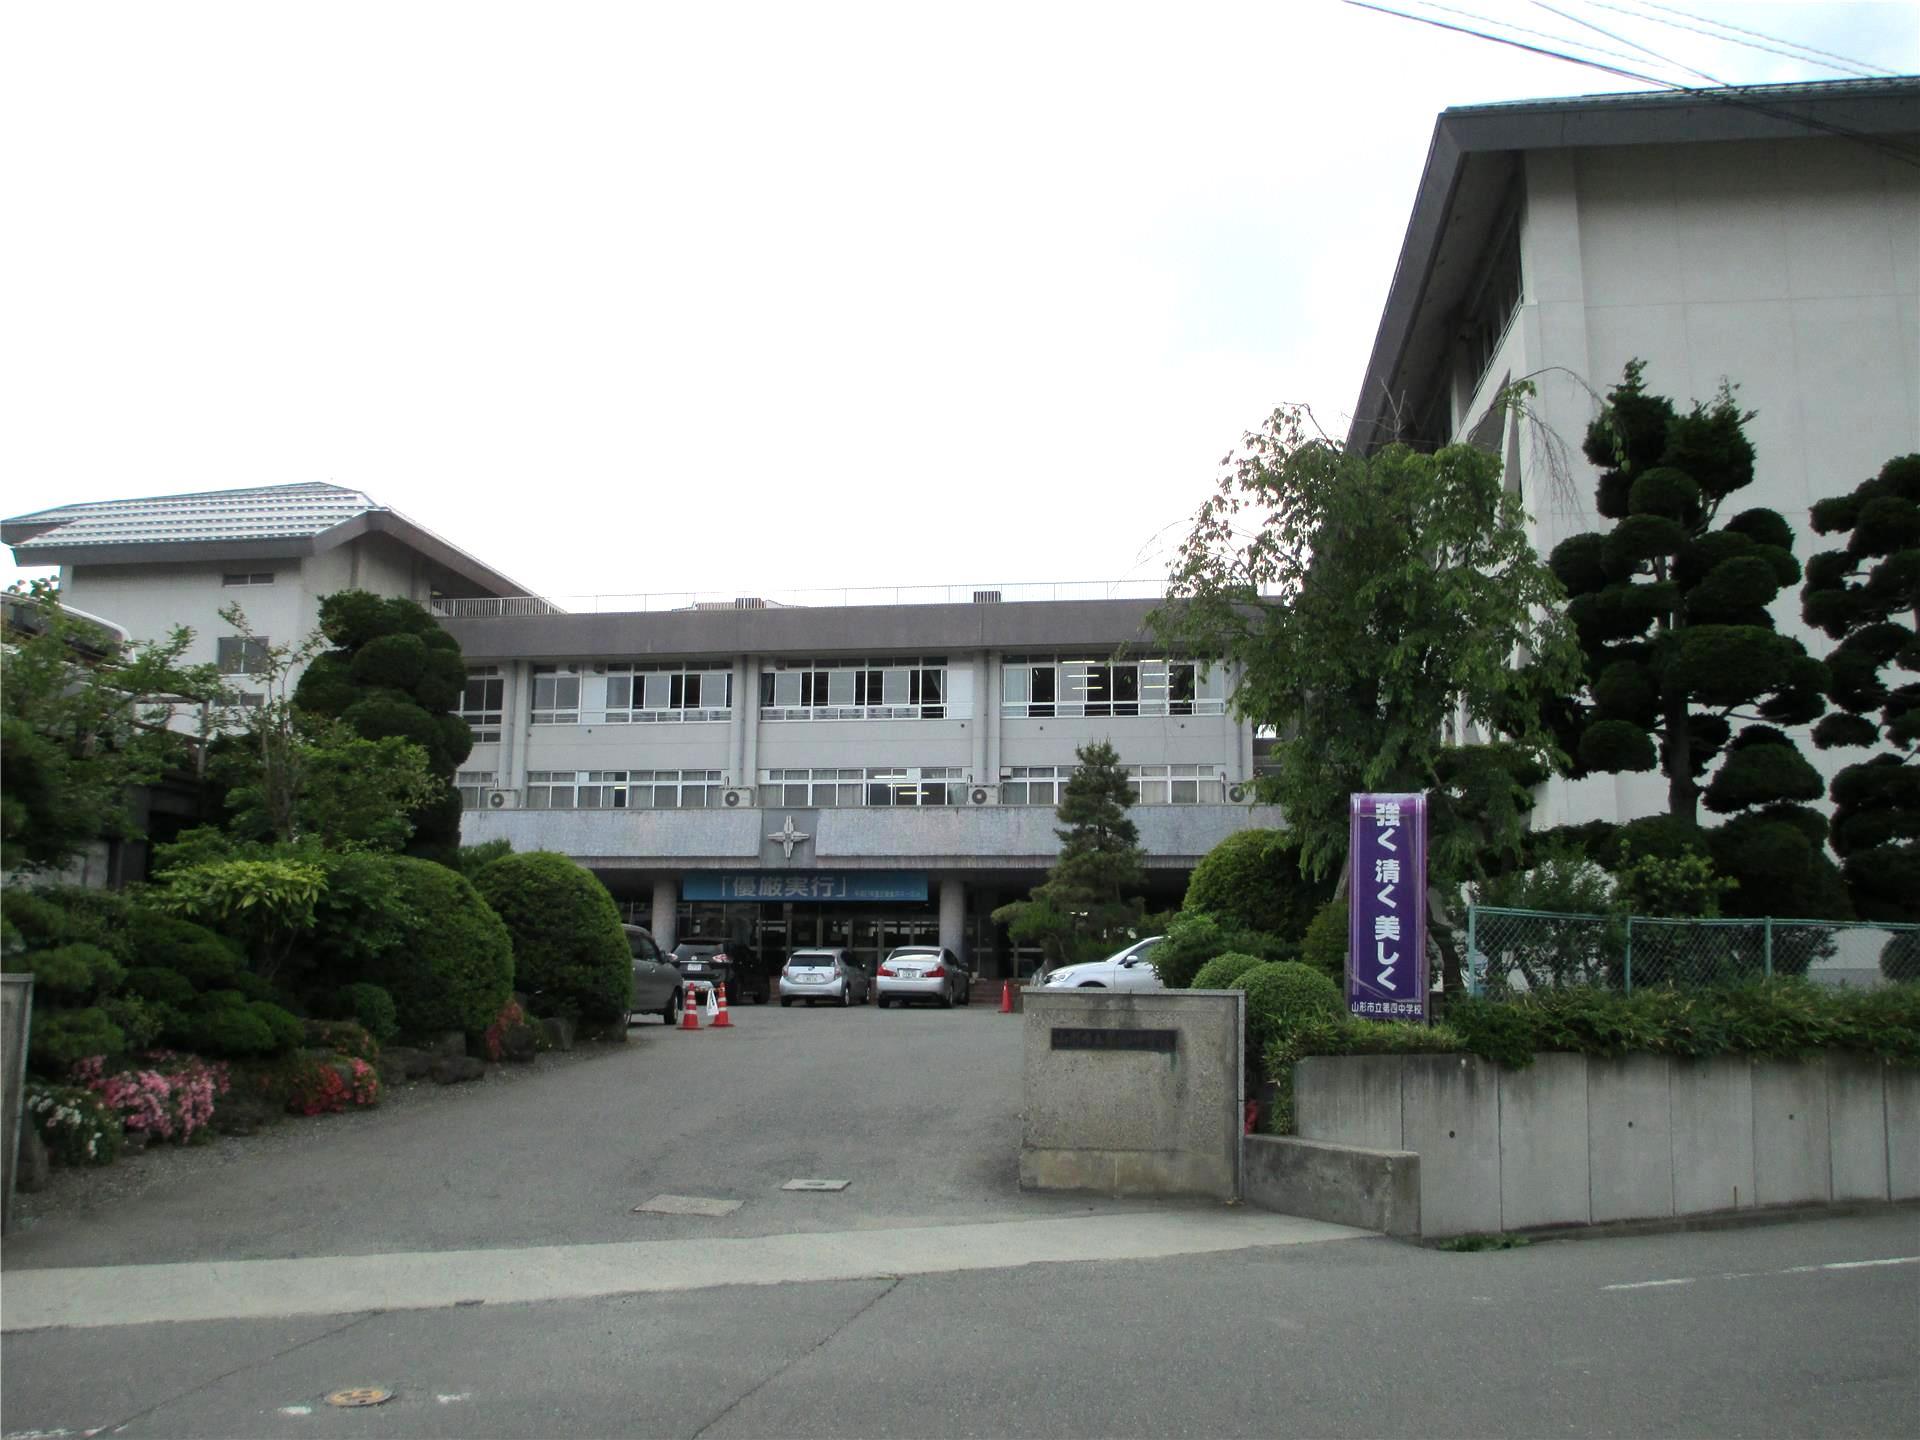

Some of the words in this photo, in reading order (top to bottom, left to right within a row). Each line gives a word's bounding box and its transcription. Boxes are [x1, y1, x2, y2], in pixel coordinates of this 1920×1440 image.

[1375, 802, 1400, 852] 強く
[1375, 858, 1400, 909] 清く
[1374, 915, 1400, 991] 美しく
[1351, 1001, 1422, 1015] 山形市立第四中学校
